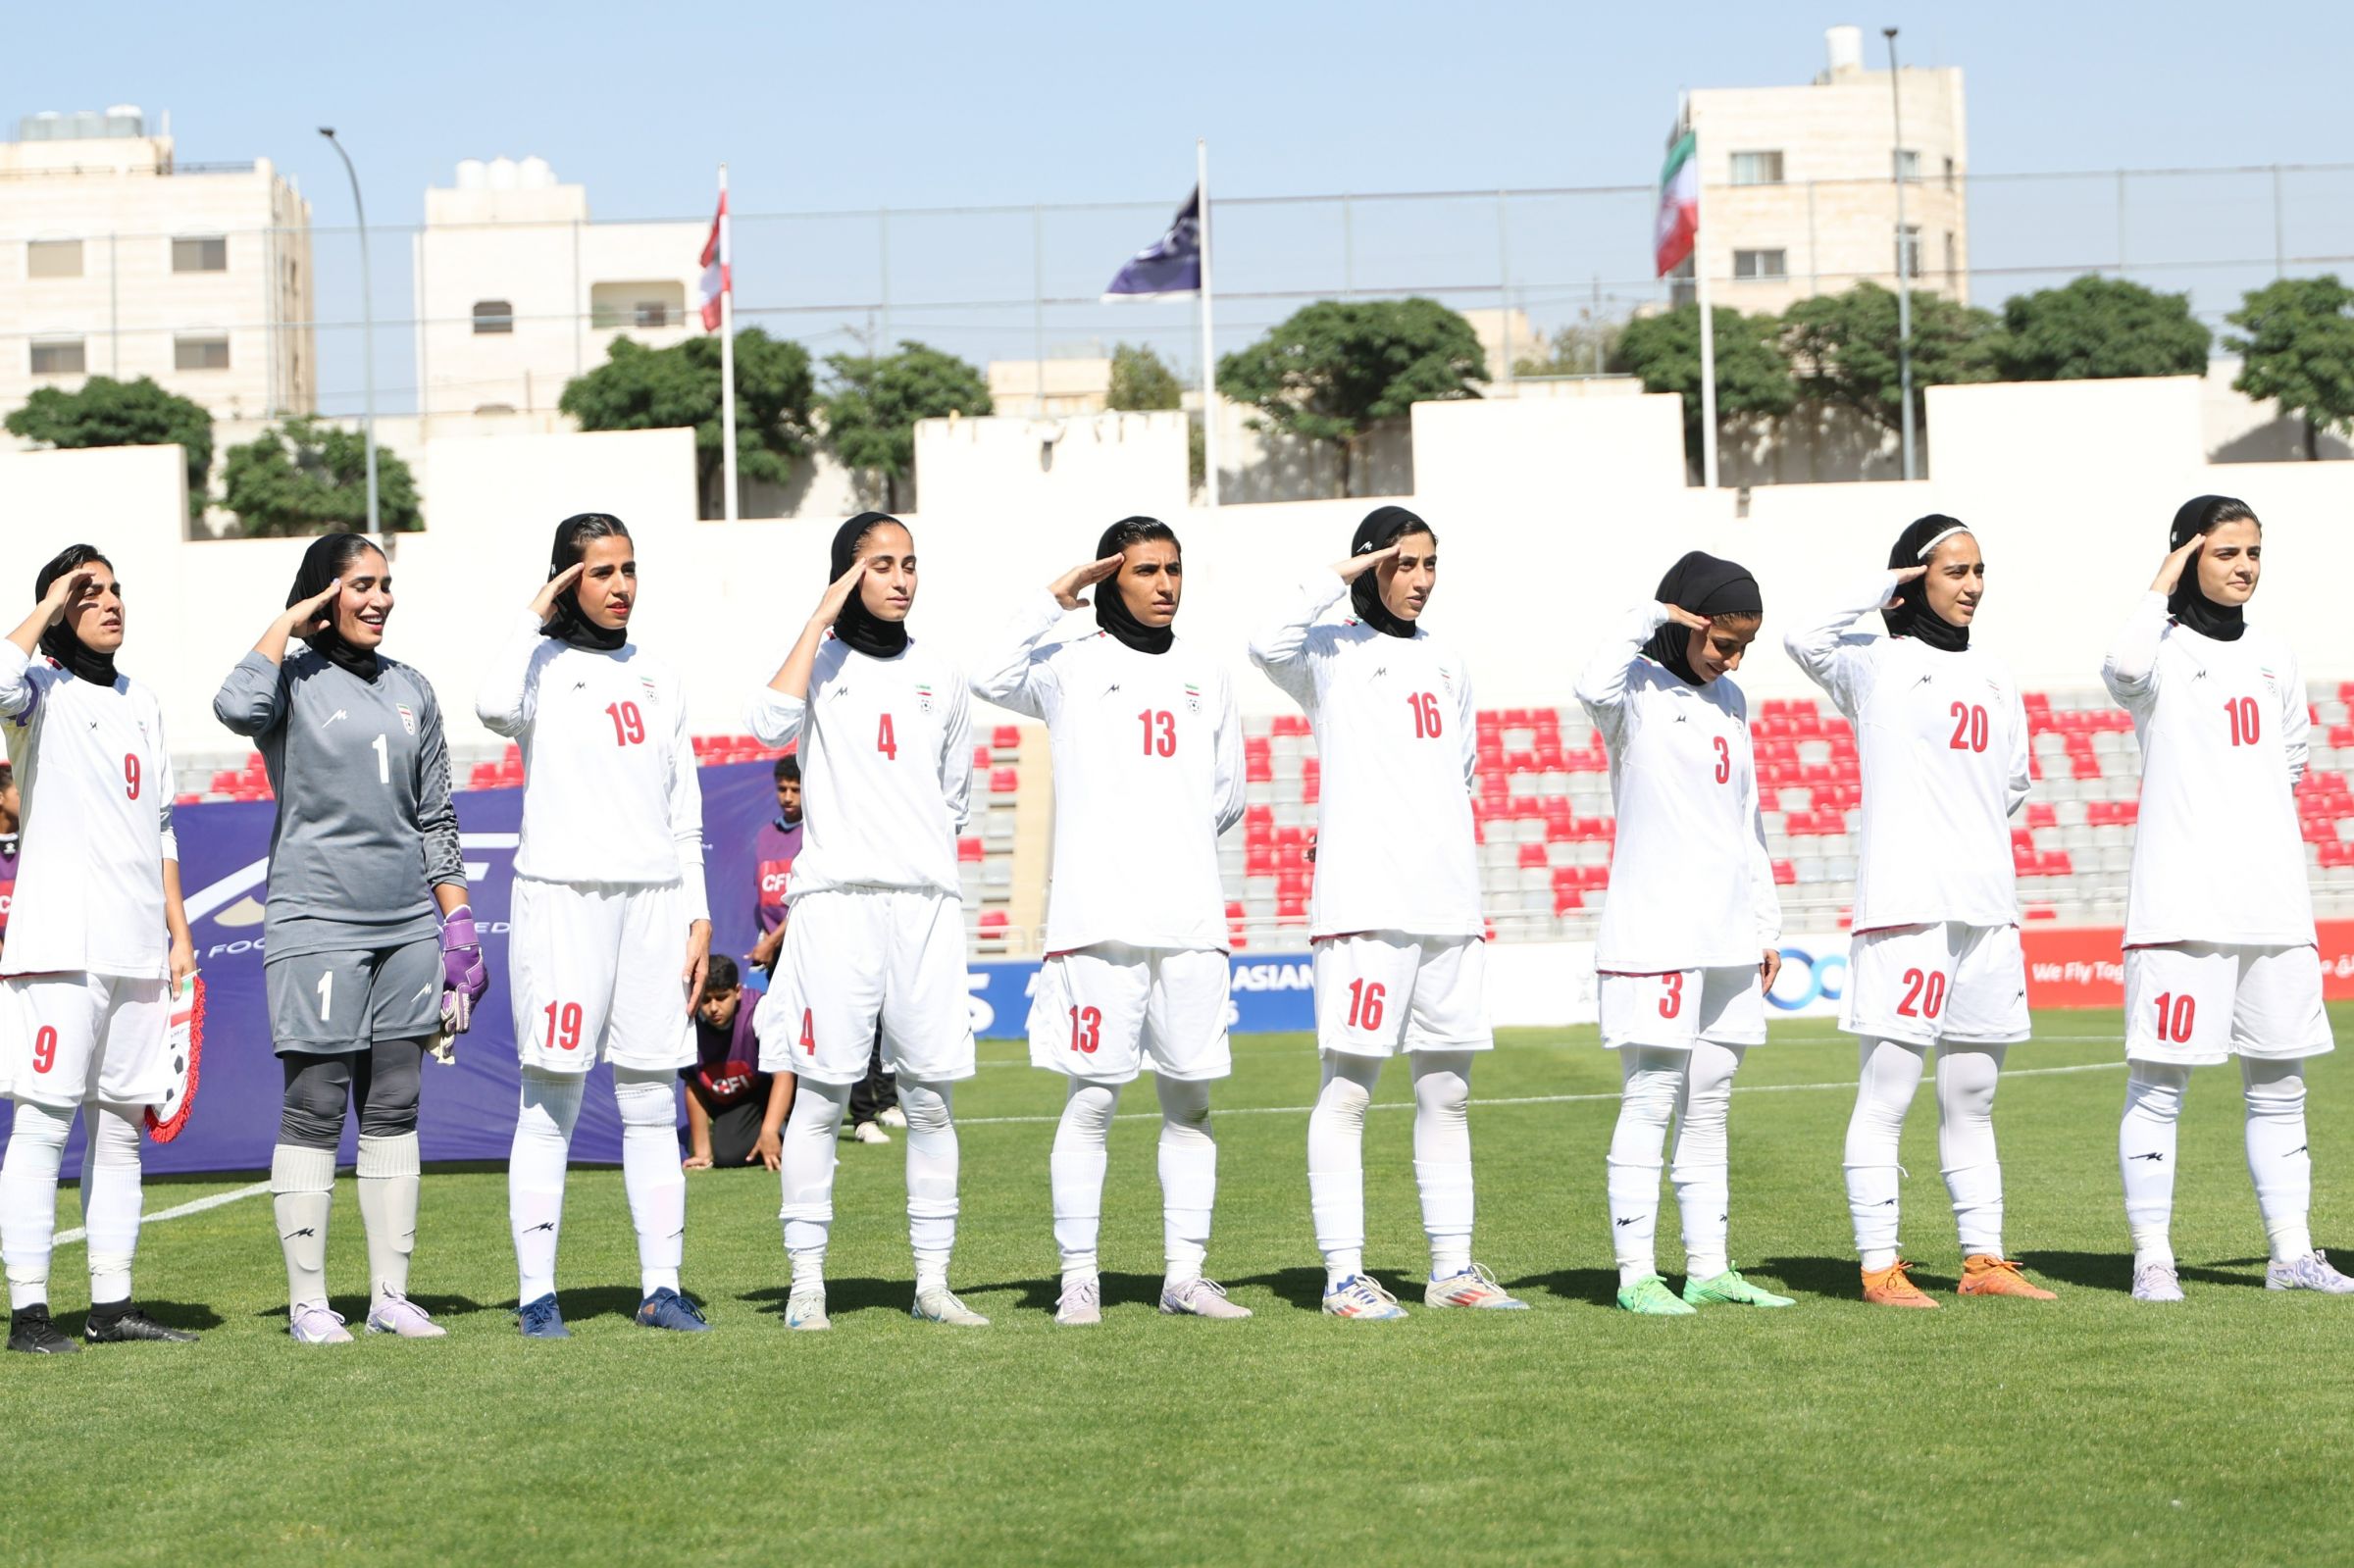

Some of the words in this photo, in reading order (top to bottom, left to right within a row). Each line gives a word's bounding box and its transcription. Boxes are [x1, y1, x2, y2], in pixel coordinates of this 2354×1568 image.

[605, 700, 645, 747] 19
[878, 713, 897, 761] 4
[1138, 708, 1177, 758] 13
[1407, 691, 1443, 738] 16
[1949, 701, 1989, 754] 20
[2224, 696, 2261, 747] 10
[125, 752, 140, 800] 9
[372, 733, 389, 784] 1
[1714, 735, 1730, 784] 3
[317, 971, 333, 1021] 1
[1659, 971, 1684, 1019] 3
[1897, 968, 1946, 1020] 20
[2031, 962, 2063, 983] We
[2064, 961, 2093, 986] Fly
[544, 1001, 584, 1050] 19
[1069, 1005, 1102, 1054] 13
[1349, 978, 1386, 1032] 16
[2154, 991, 2196, 1044] 10
[32, 1025, 58, 1075] 9
[799, 1008, 815, 1056] 4
